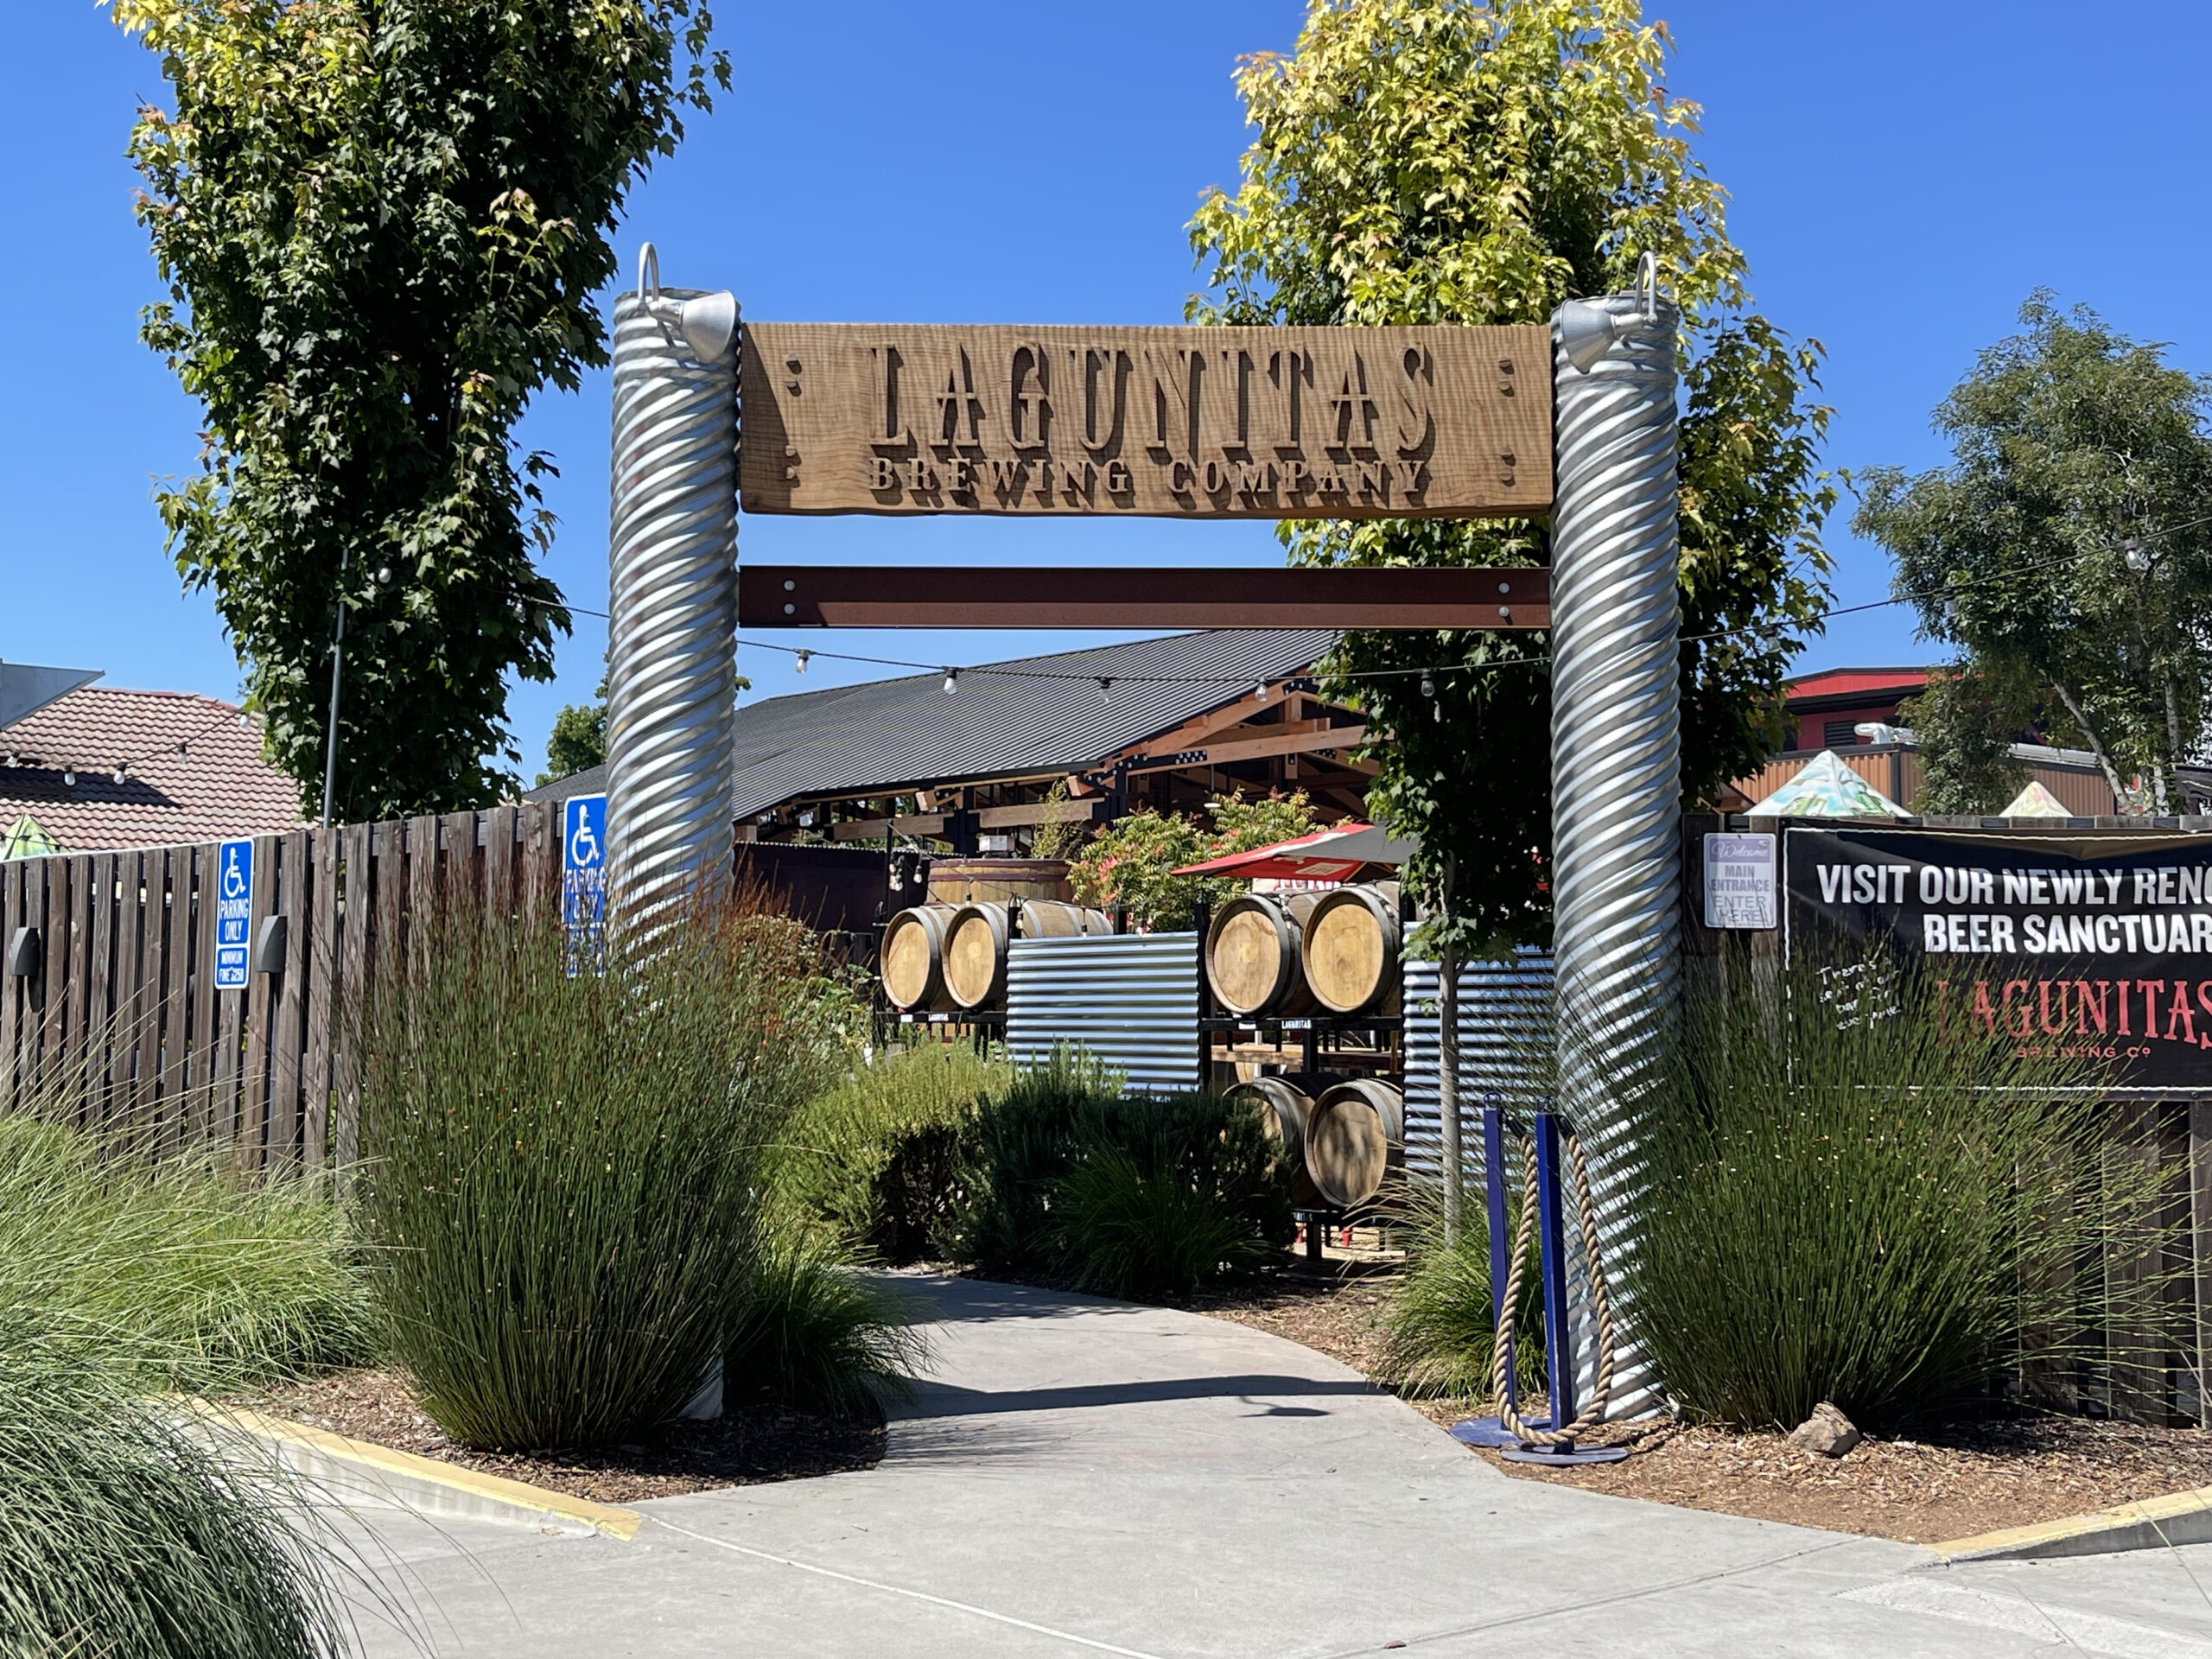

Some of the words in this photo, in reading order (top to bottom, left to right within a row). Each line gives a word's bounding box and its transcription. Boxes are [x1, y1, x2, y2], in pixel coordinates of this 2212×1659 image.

[868, 342, 1432, 453] LAGUNITAS
[868, 457, 1128, 494] BREWING
[1166, 459, 1426, 494] COMPANY
[1711, 841, 1769, 858] Welcome
[1725, 865, 1755, 878] MAIN
[1711, 879, 1770, 893] ENTRANCE
[1816, 864, 1911, 904] VISIT
[1918, 865, 1995, 906] OUR
[2001, 868, 2123, 906] NEWLY
[219, 898, 249, 919] PARKING
[1714, 895, 1767, 908] ENTER
[225, 920, 243, 941] ONLY
[1923, 913, 2016, 953] BEER
[2023, 913, 2212, 954] SANCTUAR
